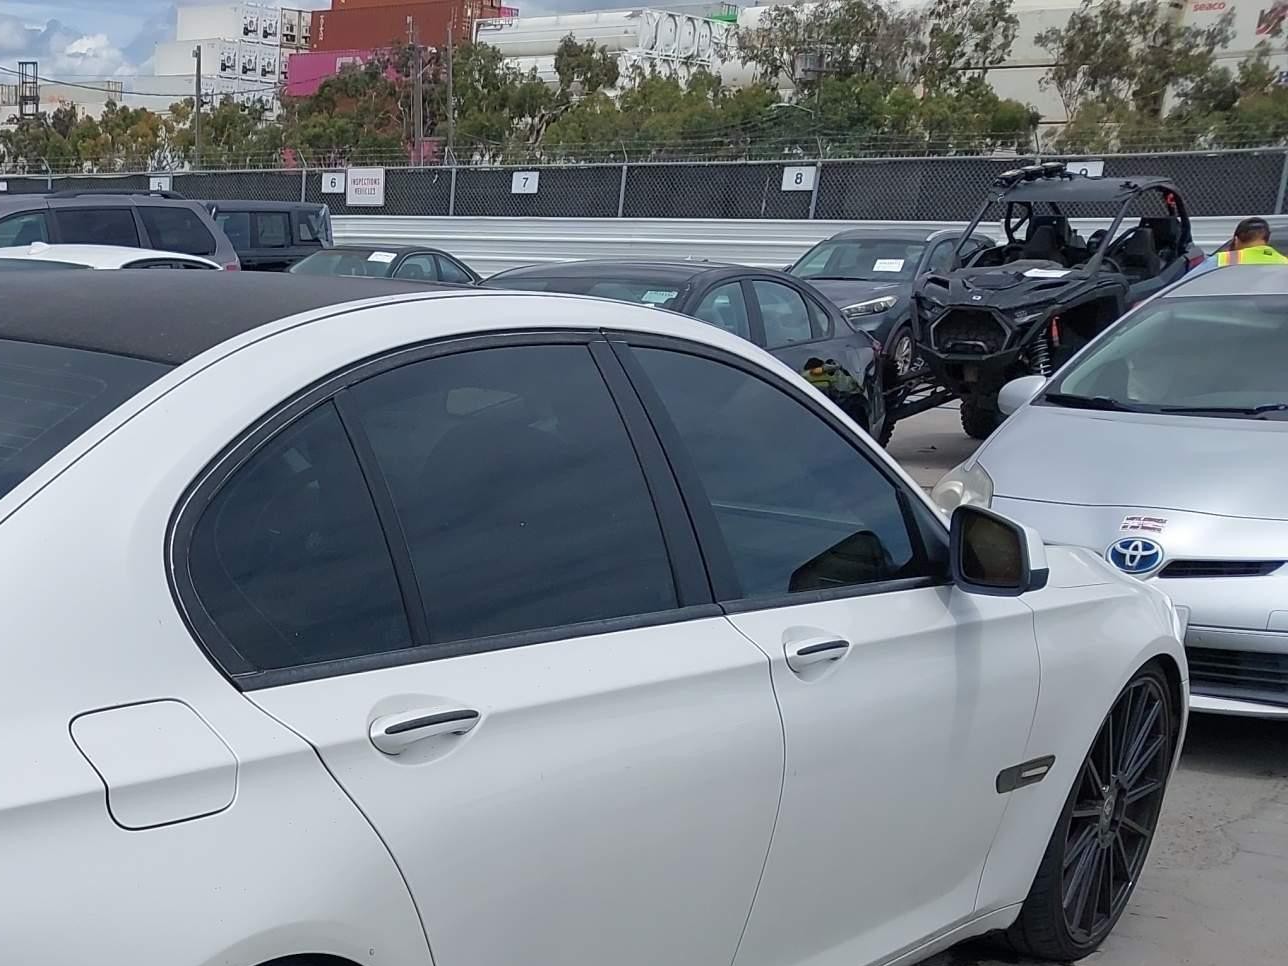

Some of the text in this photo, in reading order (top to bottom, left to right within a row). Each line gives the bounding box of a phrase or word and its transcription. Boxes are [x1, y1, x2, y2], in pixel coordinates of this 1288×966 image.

[1193, 2, 1226, 12] seaco
[330, 177, 337, 188] 6
[522, 177, 529, 188] 7
[794, 172, 803, 185] 8
